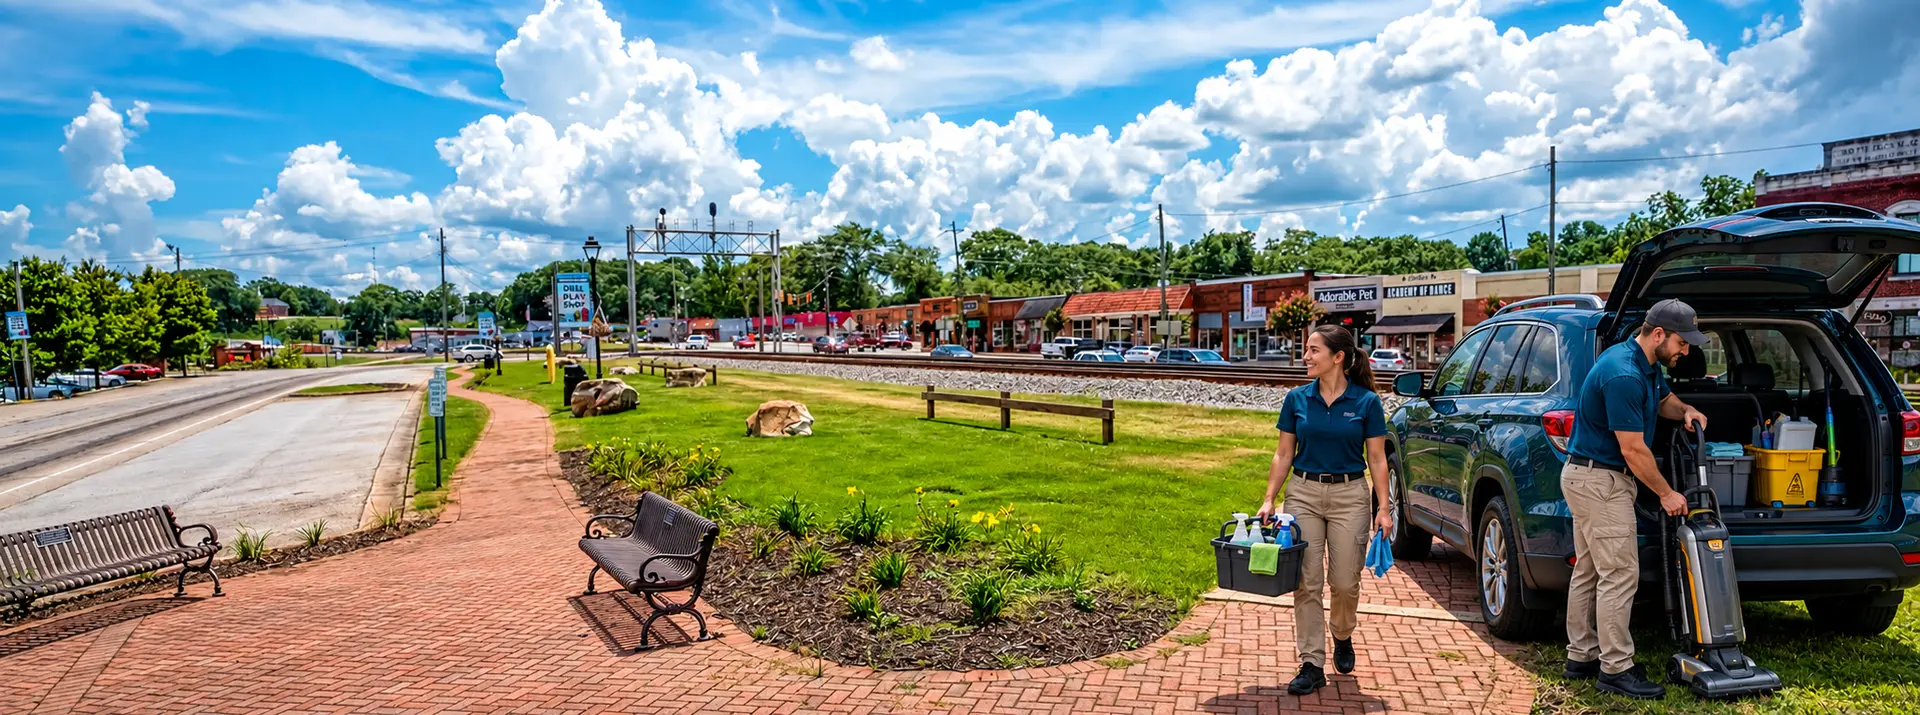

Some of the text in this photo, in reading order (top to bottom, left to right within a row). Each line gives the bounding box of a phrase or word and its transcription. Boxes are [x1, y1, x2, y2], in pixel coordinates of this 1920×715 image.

[1319, 289, 1374, 302] Adorable Pet
[1387, 284, 1452, 298] ACADEMY OF DANCE
